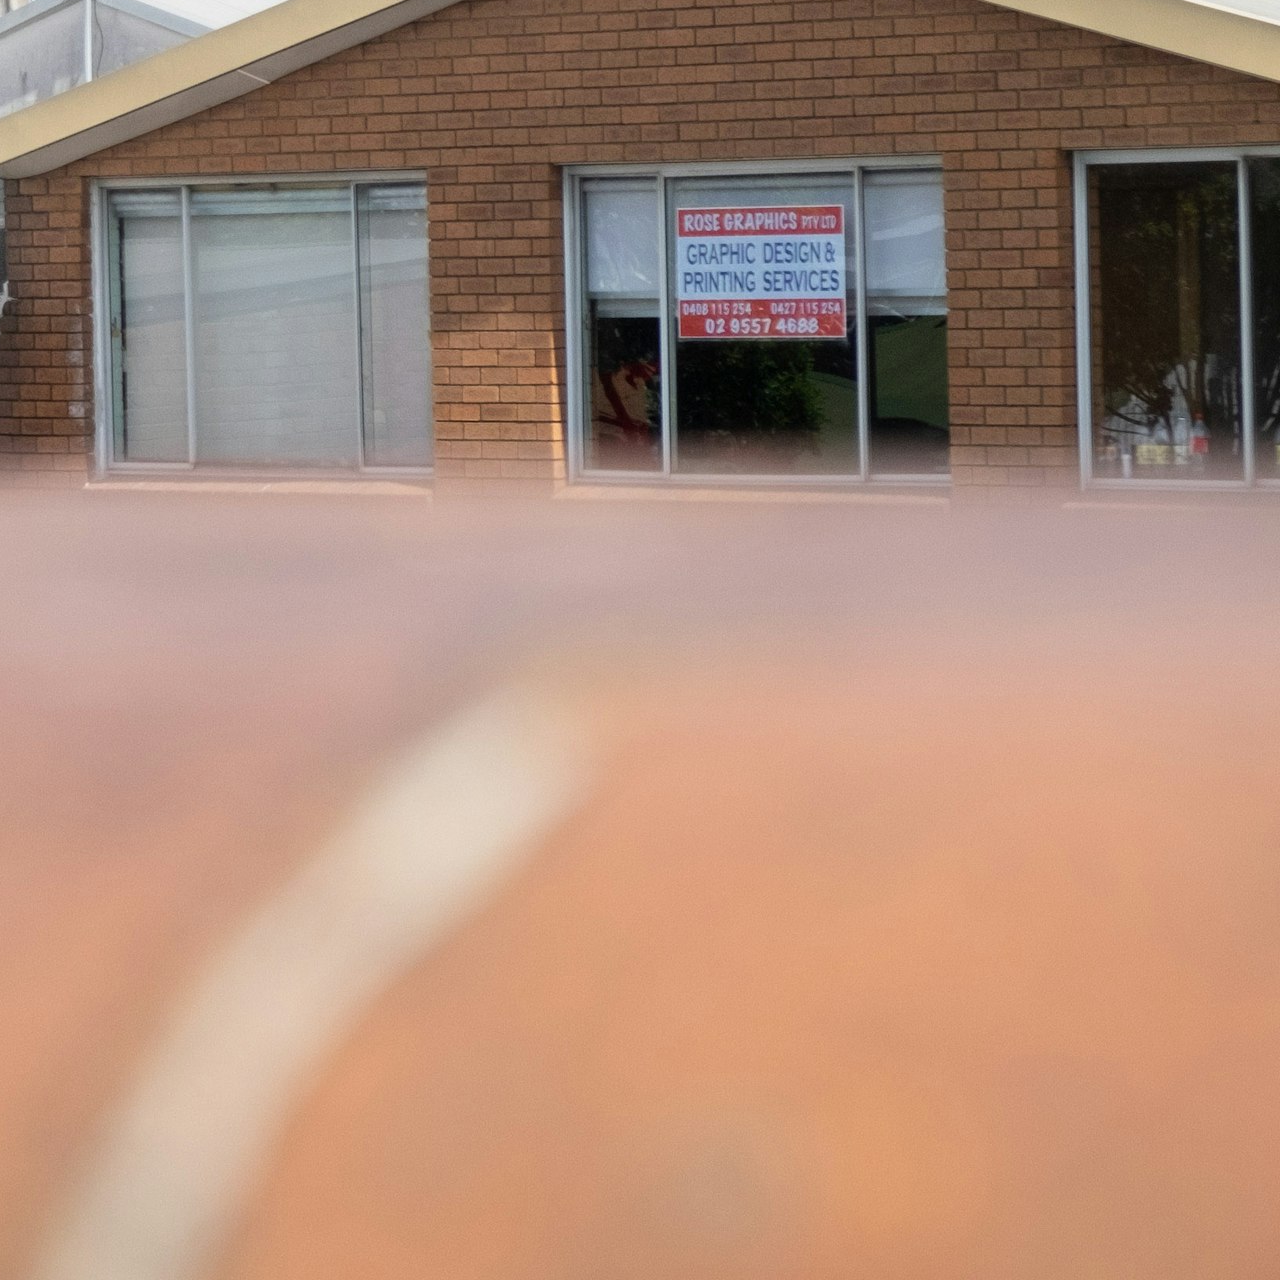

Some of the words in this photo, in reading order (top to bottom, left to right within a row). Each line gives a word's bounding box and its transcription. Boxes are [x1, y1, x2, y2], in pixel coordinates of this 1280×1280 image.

[683, 212, 721, 232] ROSE
[724, 210, 798, 230] GRAPHICS
[802, 215, 820, 229] PTY
[821, 214, 837, 228] LTD
[686, 242, 756, 265] GRAPHIC
[763, 241, 821, 264] DESIGN
[824, 241, 836, 263] &
[683, 271, 757, 293] PRINTING
[763, 269, 840, 292] SERVICES
[712, 302, 731, 315] 115
[732, 302, 752, 315] 254
[771, 301, 796, 315] 0427
[799, 301, 819, 315] 115
[821, 301, 841, 315] 254
[704, 318, 726, 334] 02
[730, 318, 772, 334] 9557
[775, 317, 819, 333] 4688
